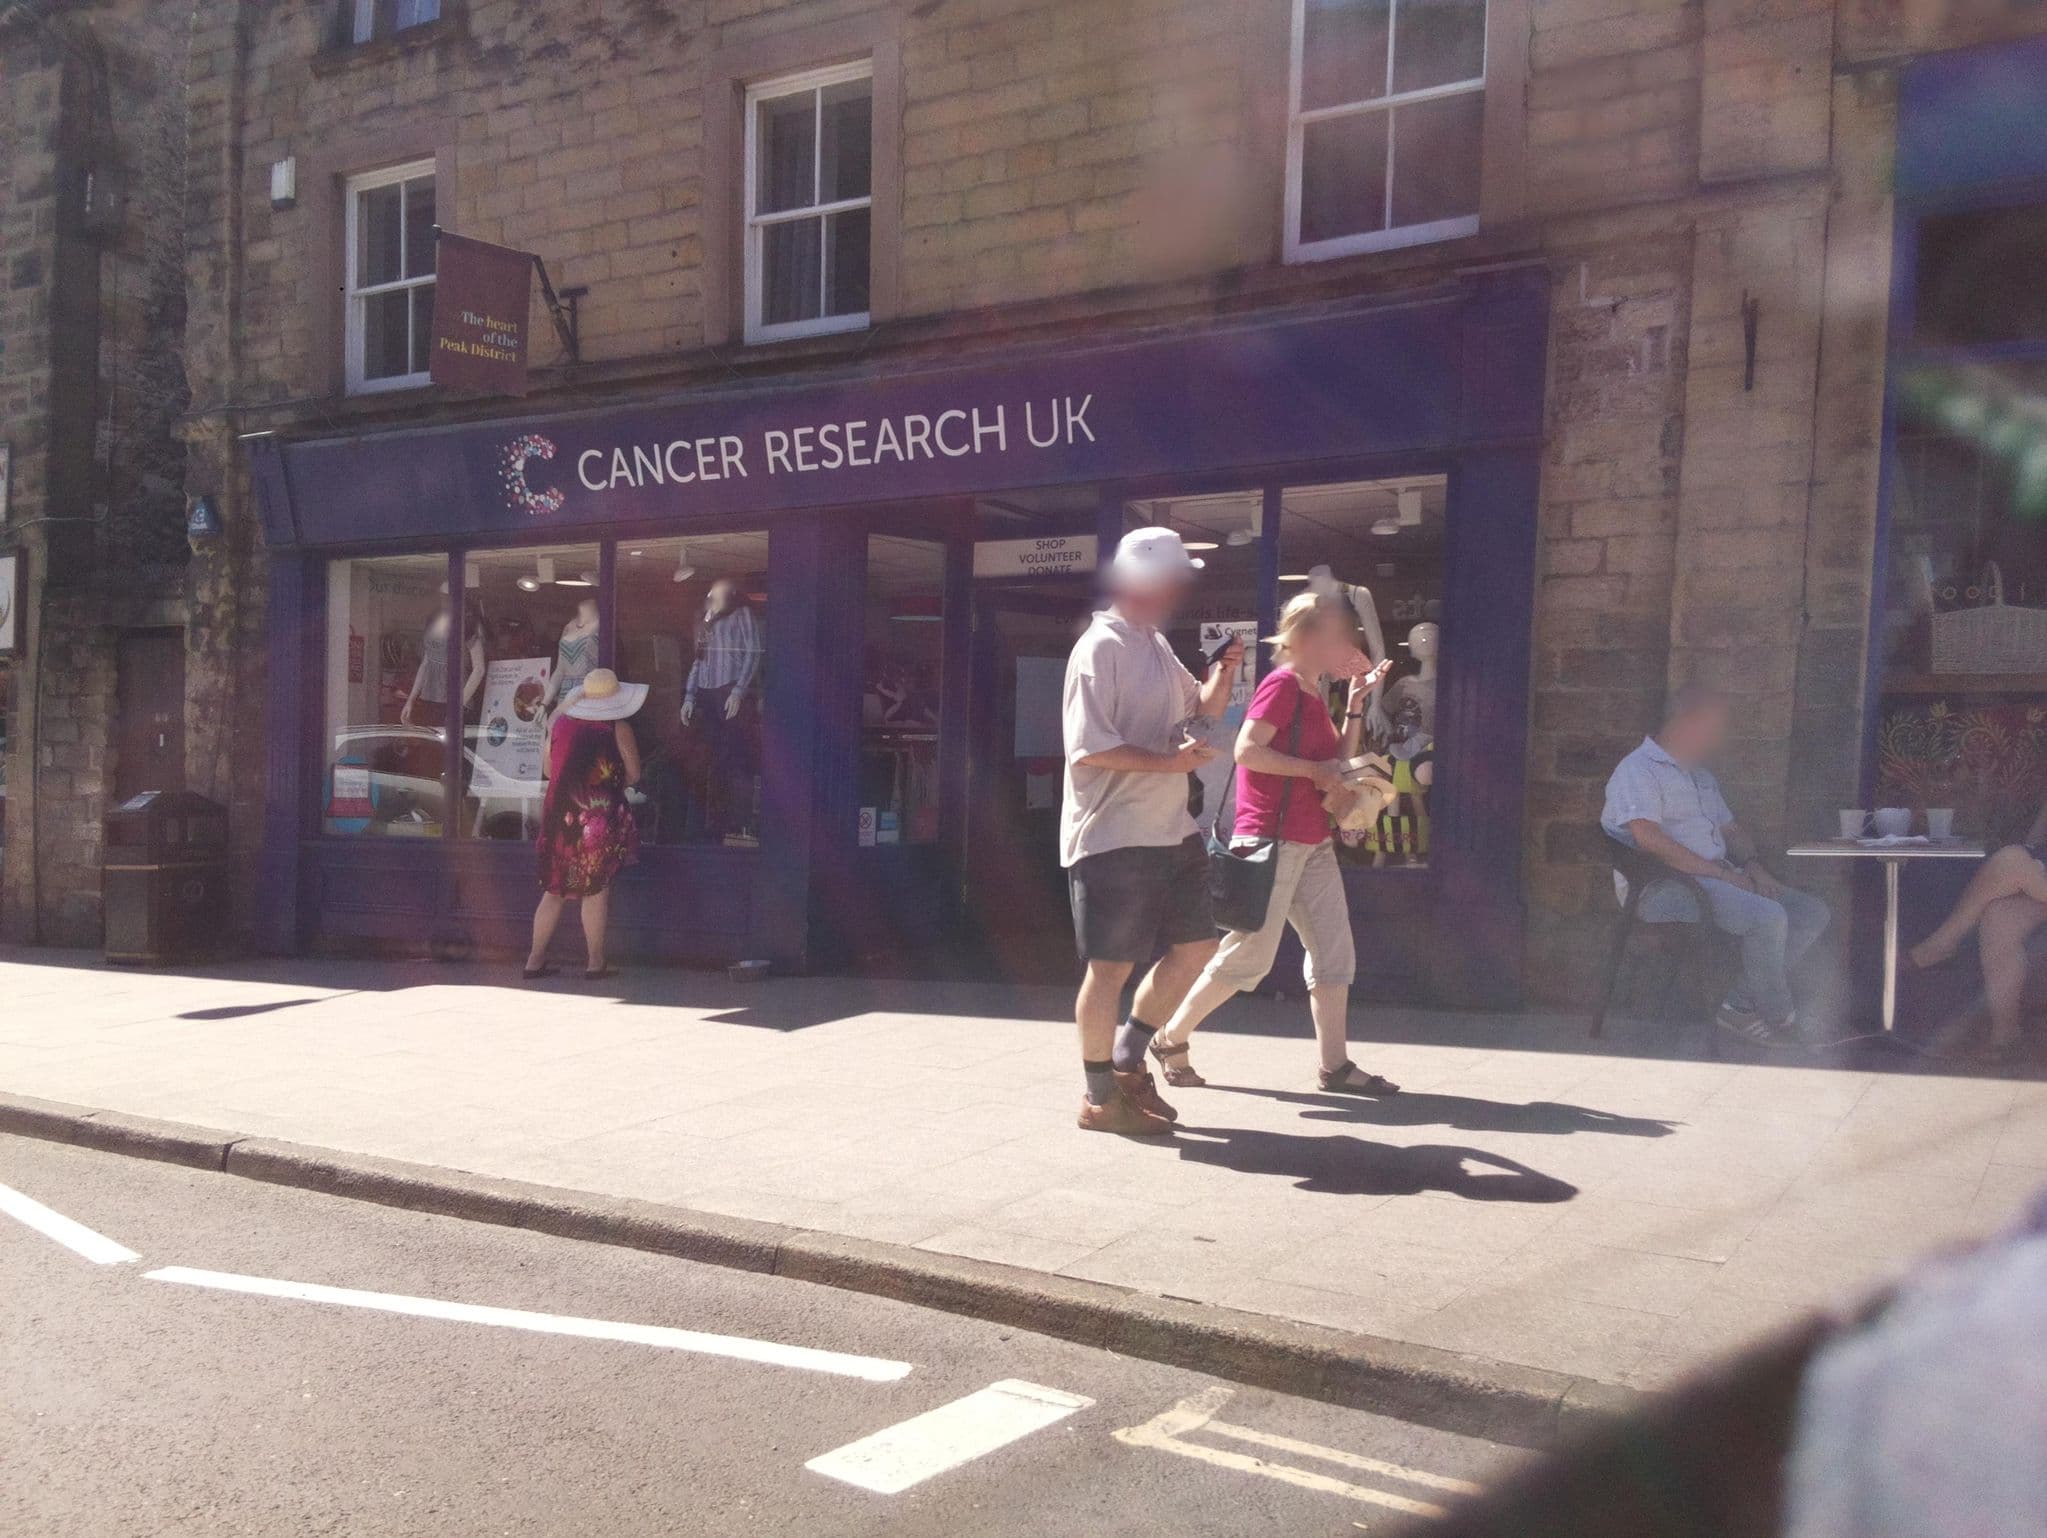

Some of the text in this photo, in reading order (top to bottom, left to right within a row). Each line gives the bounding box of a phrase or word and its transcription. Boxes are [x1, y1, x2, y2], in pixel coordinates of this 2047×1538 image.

[462, 311, 517, 333] The heart
[482, 332, 518, 348] of the
[440, 337, 516, 362] Peak District
[577, 435, 748, 491] CANCER
[764, 404, 1006, 474] RESEARCH
[1025, 394, 1096, 448] UK
[1035, 539, 1066, 550] SHOP
[1019, 551, 1082, 564] VOLUNTEER
[1028, 565, 1073, 577] DONATE
